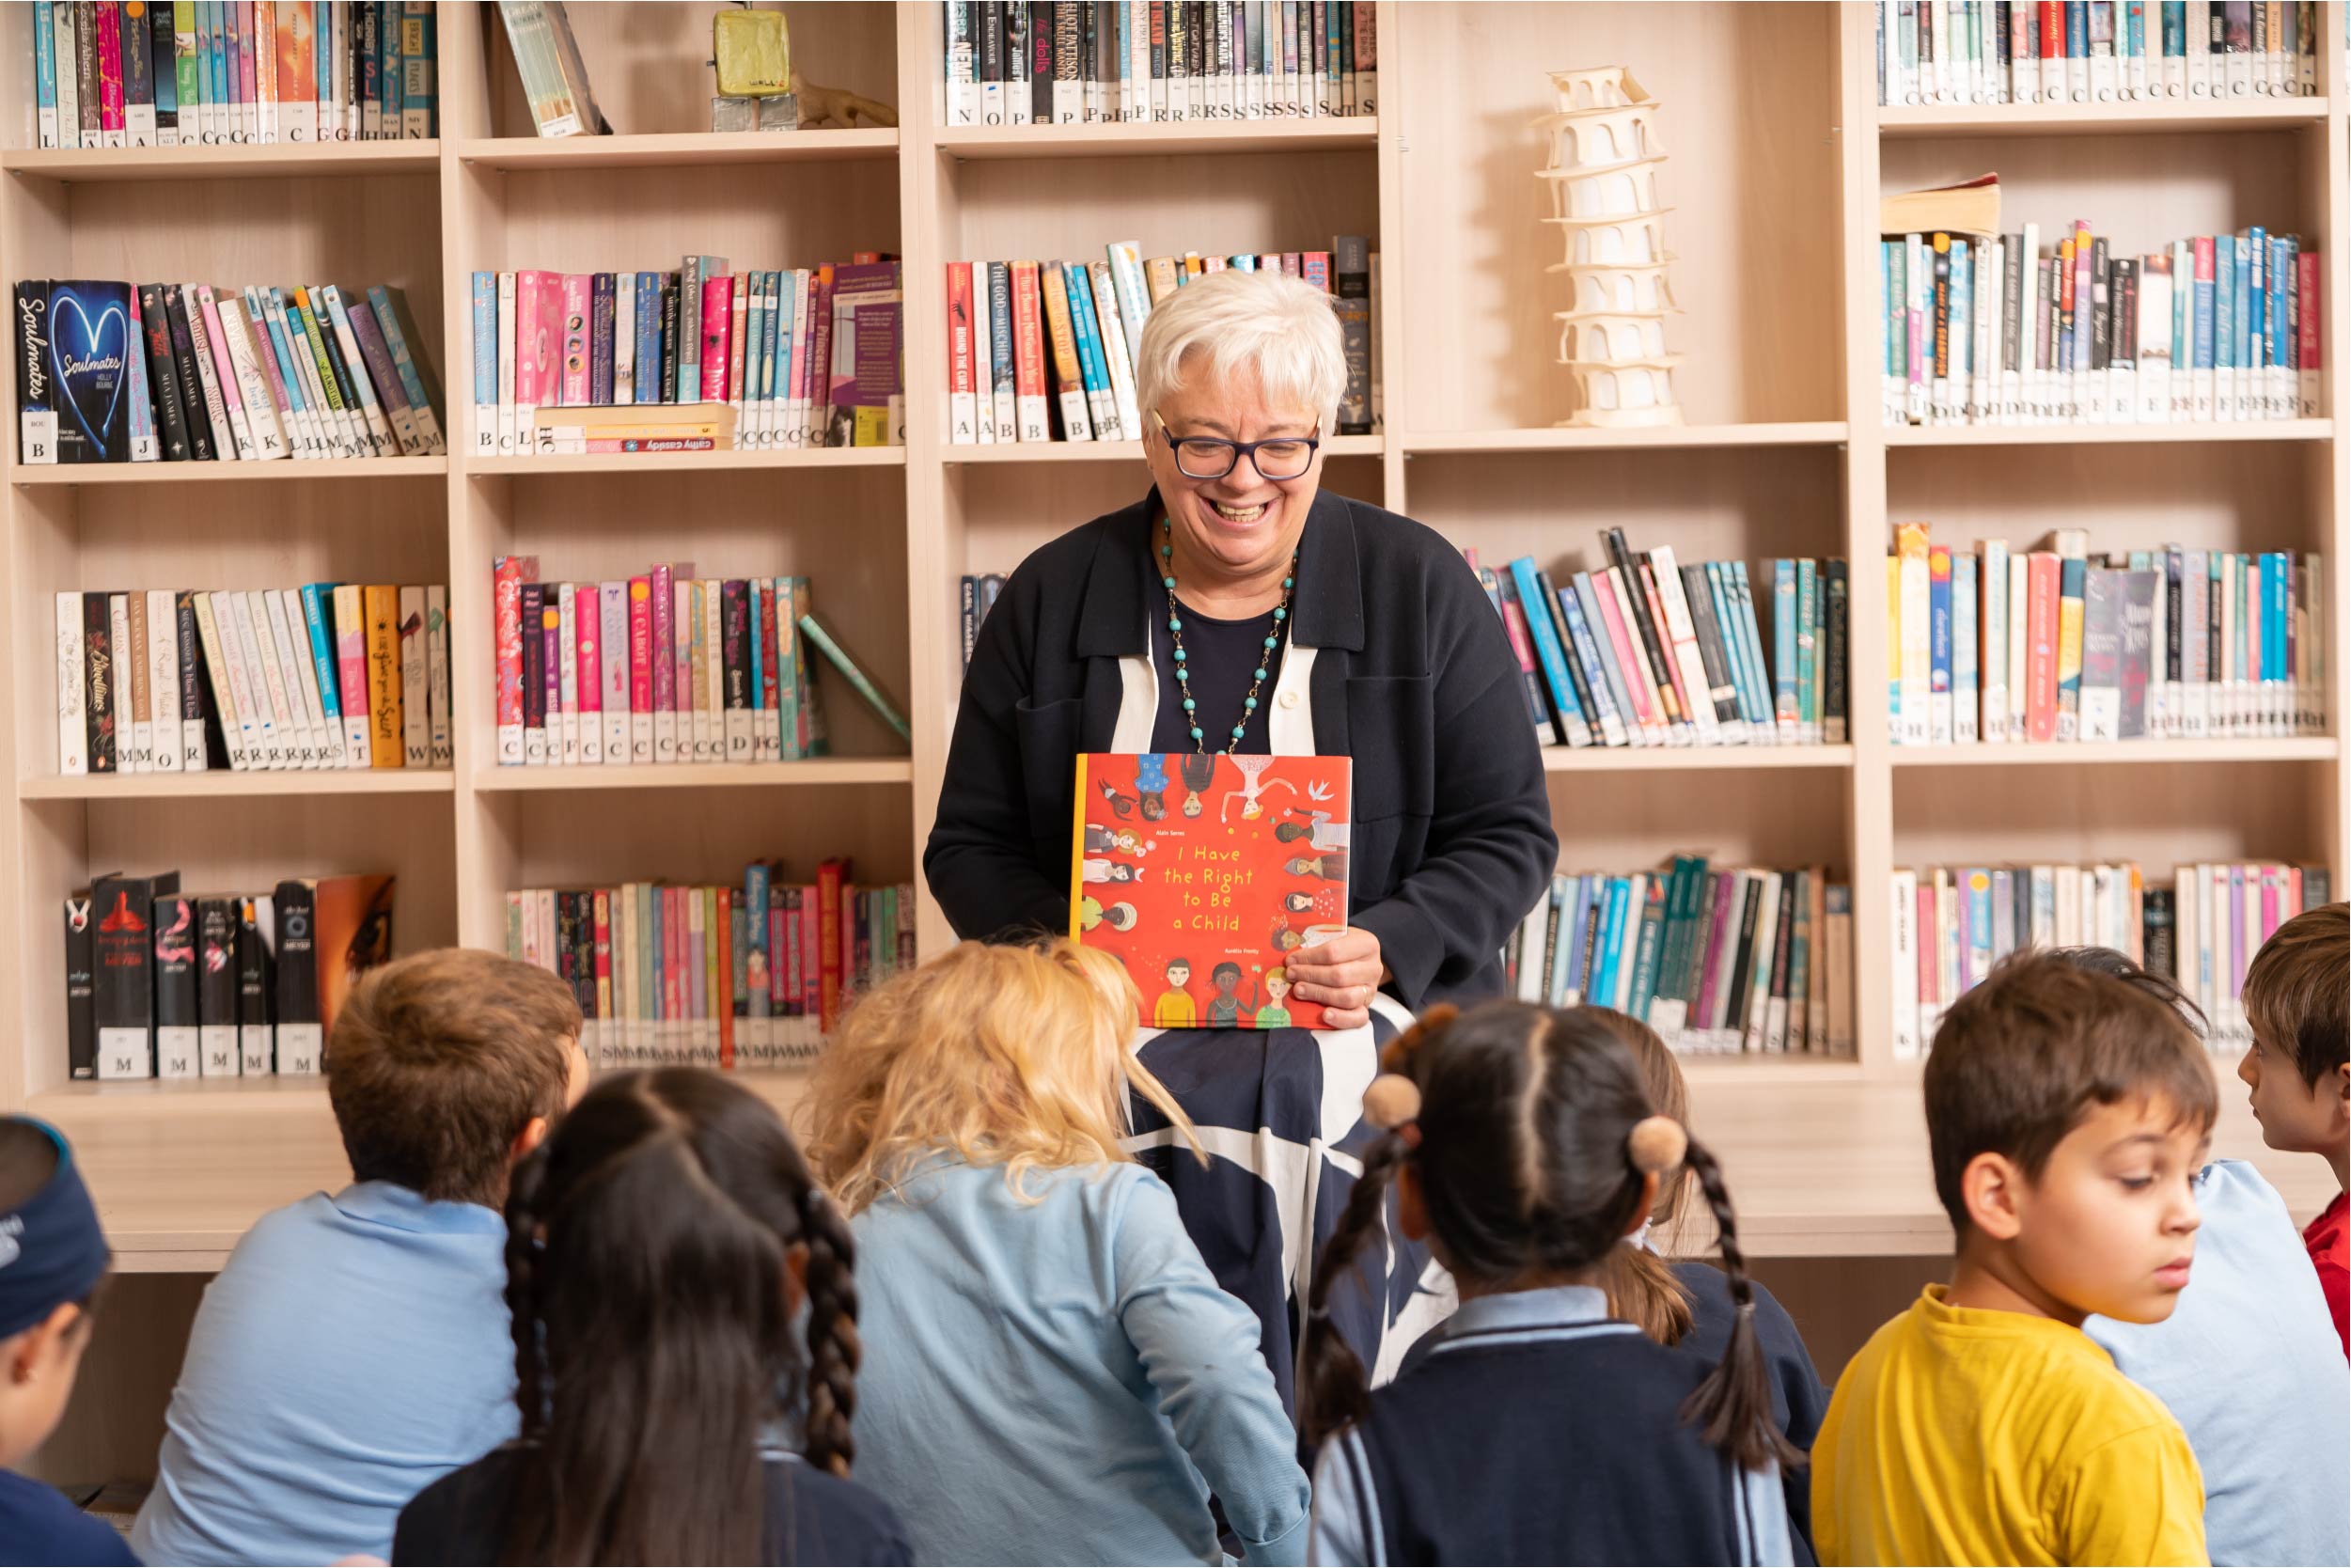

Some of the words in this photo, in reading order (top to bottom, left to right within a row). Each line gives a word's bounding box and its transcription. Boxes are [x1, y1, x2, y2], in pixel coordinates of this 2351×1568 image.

[1056, 3, 1065, 19] THE
[1066, 3, 1078, 31] ELIOT
[364, 11, 376, 55] HORNBY
[1056, 22, 1065, 46] SKULL
[1151, 9, 1163, 44] ISLAND
[987, 16, 996, 65] ENDEAVOUR
[1191, 23, 1199, 69] TORTURED
[1011, 47, 1024, 75] James
[1034, 38, 1050, 73] dolls
[1066, 34, 1078, 81] PATTISON
[1221, 103, 1230, 118] S
[1363, 99, 1374, 113] S
[959, 109, 971, 122] N
[202, 131, 213, 144] C
[231, 130, 243, 143] C
[290, 128, 302, 141] C
[993, 264, 1005, 283] THE
[1020, 276, 1033, 292] This
[995, 284, 1007, 310] GOD
[1022, 293, 1033, 313] Book
[1023, 321, 1034, 335] Not
[956, 326, 967, 353] BEHIND
[996, 317, 1009, 362] MISCHIEF
[1025, 336, 1036, 357] Good
[1056, 324, 1070, 355] STOP
[19, 297, 48, 400] Soulmates
[815, 325, 828, 375] Princess
[64, 353, 120, 377] Soulmates
[182, 355, 191, 371] MIA
[958, 355, 967, 369] THE
[162, 372, 170, 389] MIA
[957, 370, 968, 393] CURTA
[185, 372, 198, 407] JAMES
[164, 390, 178, 426] JAMES
[775, 429, 787, 443] C
[957, 421, 970, 434] A
[1001, 423, 1012, 437] B
[1071, 422, 1083, 435] B
[265, 435, 279, 449] K
[403, 434, 422, 452] M
[480, 432, 492, 446] B
[500, 435, 511, 448] C
[647, 440, 683, 451] cassidy
[684, 438, 712, 450] cathy
[33, 444, 44, 457] B
[635, 618, 646, 666] CABOT
[91, 650, 111, 712] Bloodlines
[549, 688, 557, 713] MISSI
[610, 743, 622, 757] C
[635, 742, 647, 755] C
[661, 737, 673, 751] C
[136, 749, 151, 761] M
[159, 753, 171, 767] O
[187, 748, 199, 760] R
[1178, 846, 1183, 861] I
[1195, 845, 1240, 862] Have
[1164, 868, 1193, 884] the
[1203, 868, 1253, 894] Right
[1183, 890, 1200, 907] to
[1210, 892, 1231, 908] Be
[1173, 918, 1183, 930] a
[1192, 915, 1239, 933] Child
[213, 1053, 227, 1066] M
[248, 1055, 261, 1068] M
[296, 1058, 310, 1071] M
